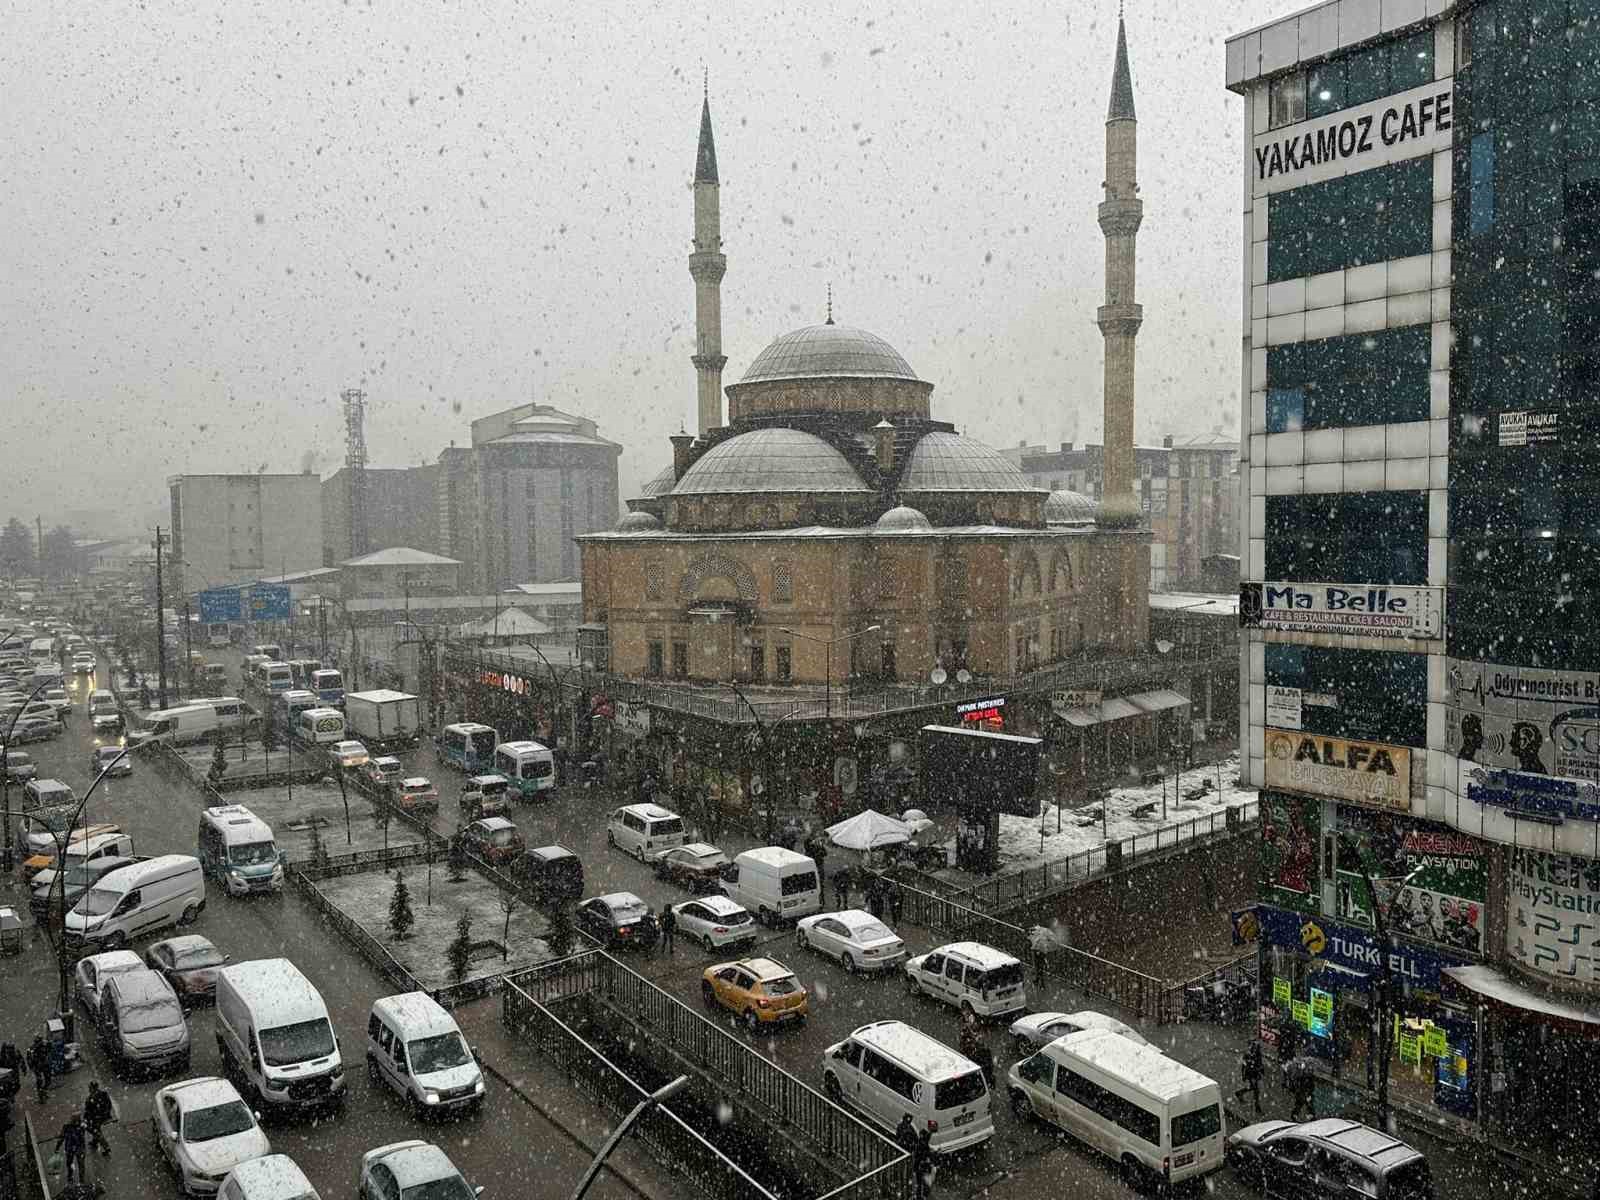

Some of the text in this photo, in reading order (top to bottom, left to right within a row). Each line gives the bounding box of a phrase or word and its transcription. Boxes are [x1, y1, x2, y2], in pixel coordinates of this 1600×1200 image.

[1255, 92, 1451, 179] YAKAMOZ CAFE
[1527, 413, 1558, 425] AVUKAT
[1266, 586, 1313, 609] Ma
[1326, 587, 1407, 613] Belle
[1264, 610, 1286, 621] CAFE
[1293, 611, 1349, 624] RESTAURANT
[1350, 614, 1373, 626] OKEY
[1373, 616, 1411, 627] SALONU
[1294, 737, 1397, 776] ALFA
[1401, 832, 1480, 856] ARENA
[1407, 855, 1480, 870] PLAYSTATION
